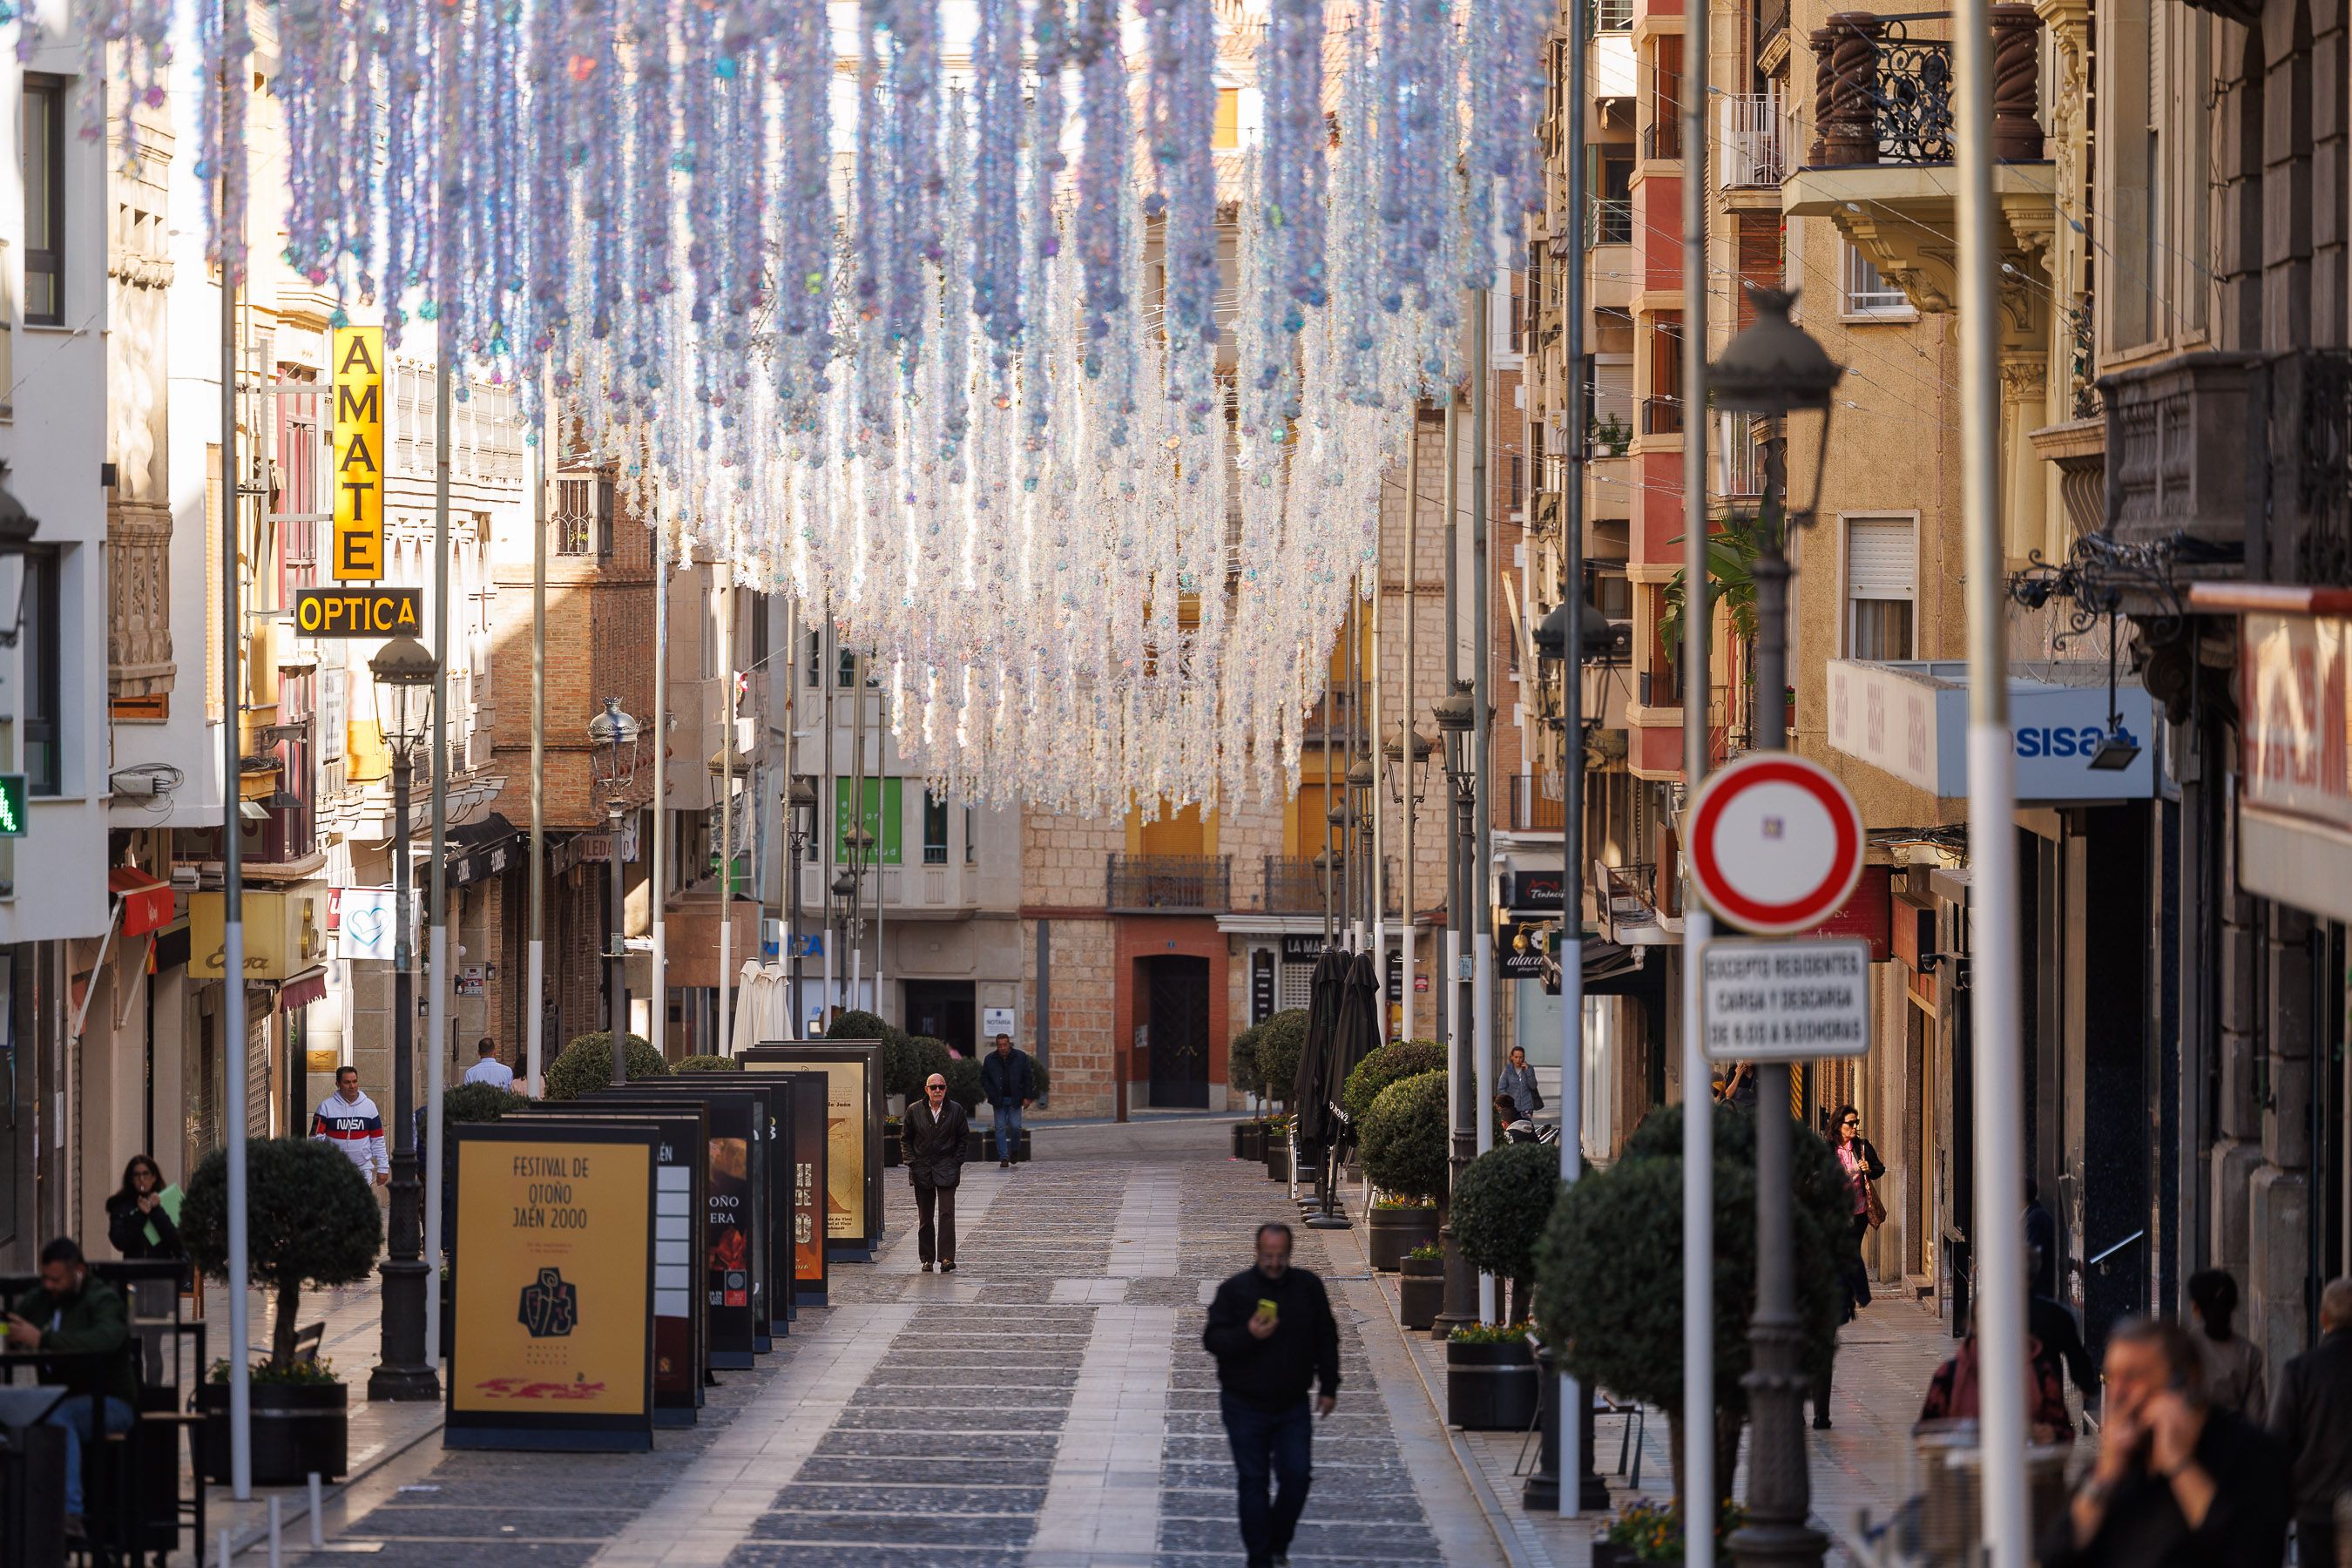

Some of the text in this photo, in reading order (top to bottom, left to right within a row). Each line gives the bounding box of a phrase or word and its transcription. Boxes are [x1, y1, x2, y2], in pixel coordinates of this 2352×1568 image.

[338, 335, 378, 570] AMATE
[299, 597, 416, 631] OPTICA
[2006, 727, 2106, 758] sisa
[1507, 953, 1544, 966] alaca
[1707, 951, 1859, 980] EXCEPTO RESIDENTES
[1717, 990, 1765, 1013] CARGA
[1781, 986, 1853, 1010] DESCARGA
[336, 1119, 365, 1131] NASA
[512, 1156, 589, 1178] FESTIVAL DE
[529, 1181, 571, 1205] OTOÑO
[512, 1204, 588, 1229] JAÉN 2000
